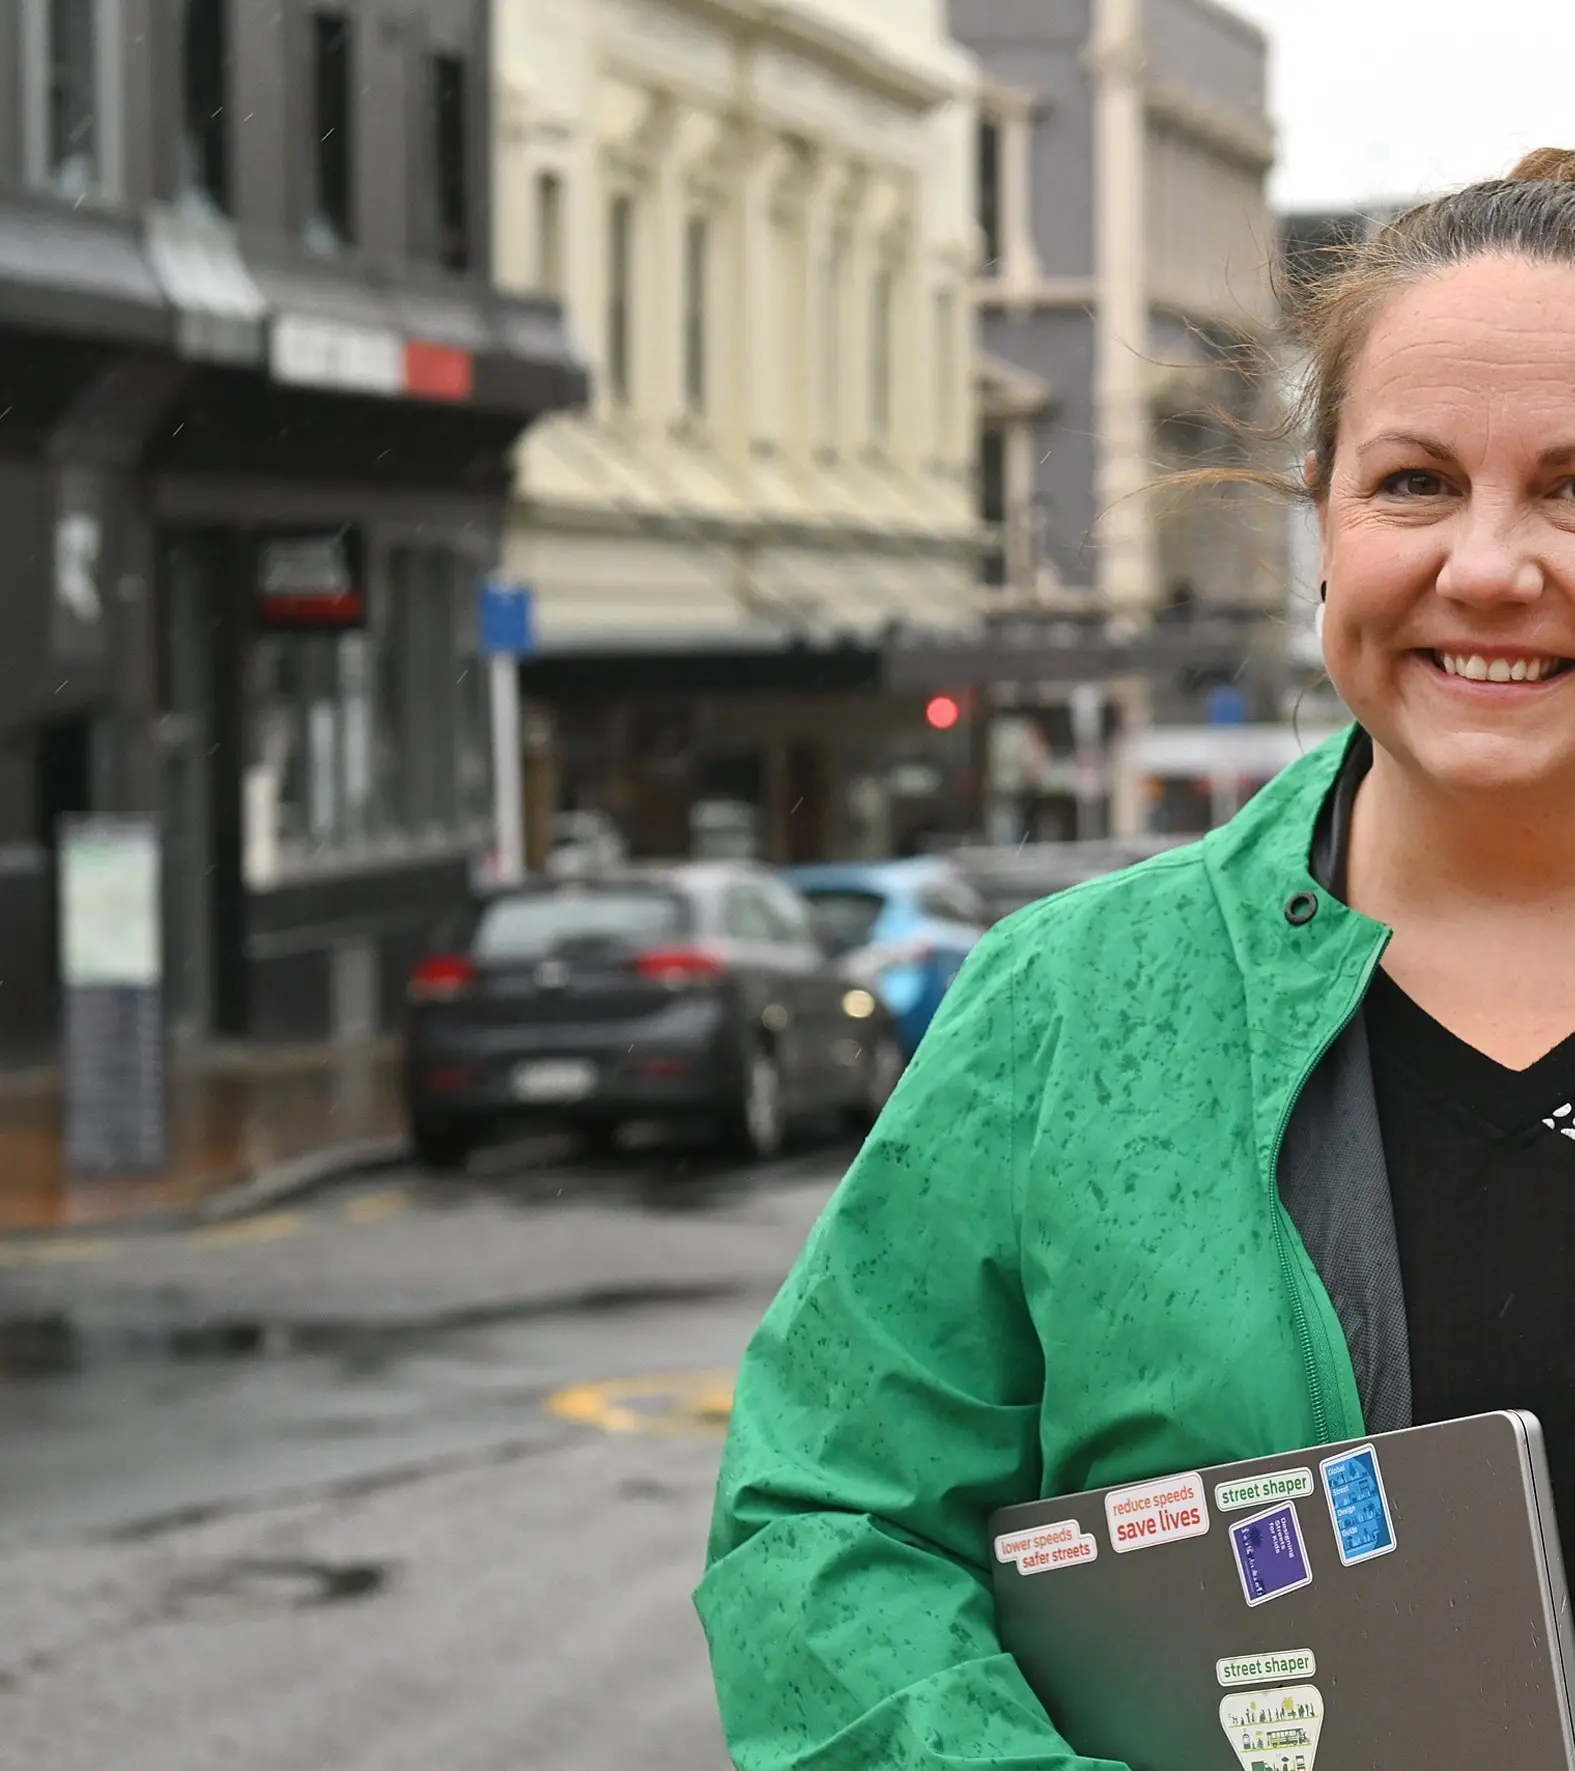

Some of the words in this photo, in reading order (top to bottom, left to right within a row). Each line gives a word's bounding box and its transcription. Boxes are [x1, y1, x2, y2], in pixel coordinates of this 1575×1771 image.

[1328, 1464, 1346, 1476] Global
[1113, 1497, 1151, 1516] reduce
[1153, 1485, 1194, 1508] speeds
[1222, 1483, 1260, 1504] street
[1263, 1477, 1306, 1495] shaper
[1332, 1485, 1349, 1496] Street
[1117, 1517, 1157, 1541] save
[1159, 1507, 1200, 1531] lives
[1274, 1520, 1286, 1550] Streets
[1001, 1537, 1031, 1555] lower
[1034, 1528, 1073, 1550] speeds
[1272, 1535, 1280, 1554] Kids
[1280, 1517, 1295, 1559] Designing
[1023, 1551, 1050, 1568] safer
[1052, 1543, 1091, 1562] streets
[1223, 1659, 1262, 1678] street
[1264, 1657, 1309, 1674] shaper
